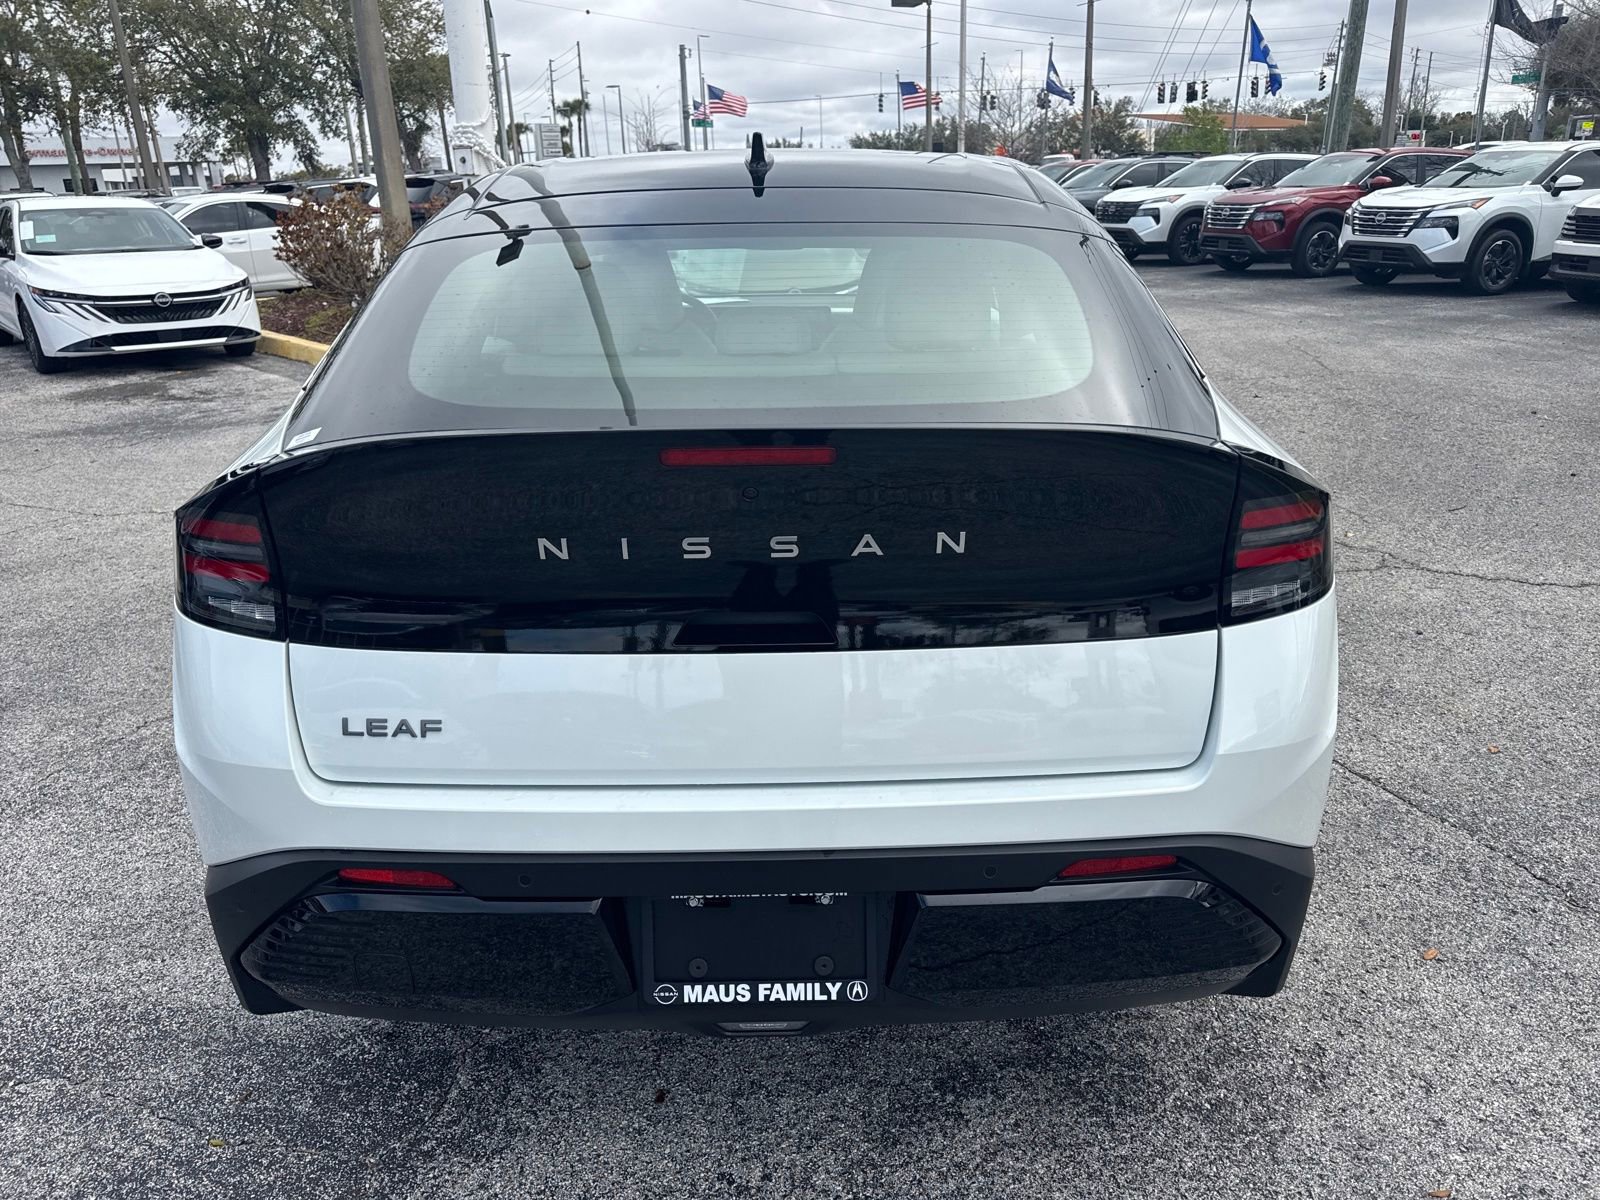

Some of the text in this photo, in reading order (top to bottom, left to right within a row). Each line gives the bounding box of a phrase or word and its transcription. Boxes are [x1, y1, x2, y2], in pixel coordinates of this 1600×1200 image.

[537, 531, 967, 561] NISSAN
[341, 717, 443, 738] LEAF
[683, 983, 752, 1003] MAUS
[758, 982, 843, 1002] FAMILY
